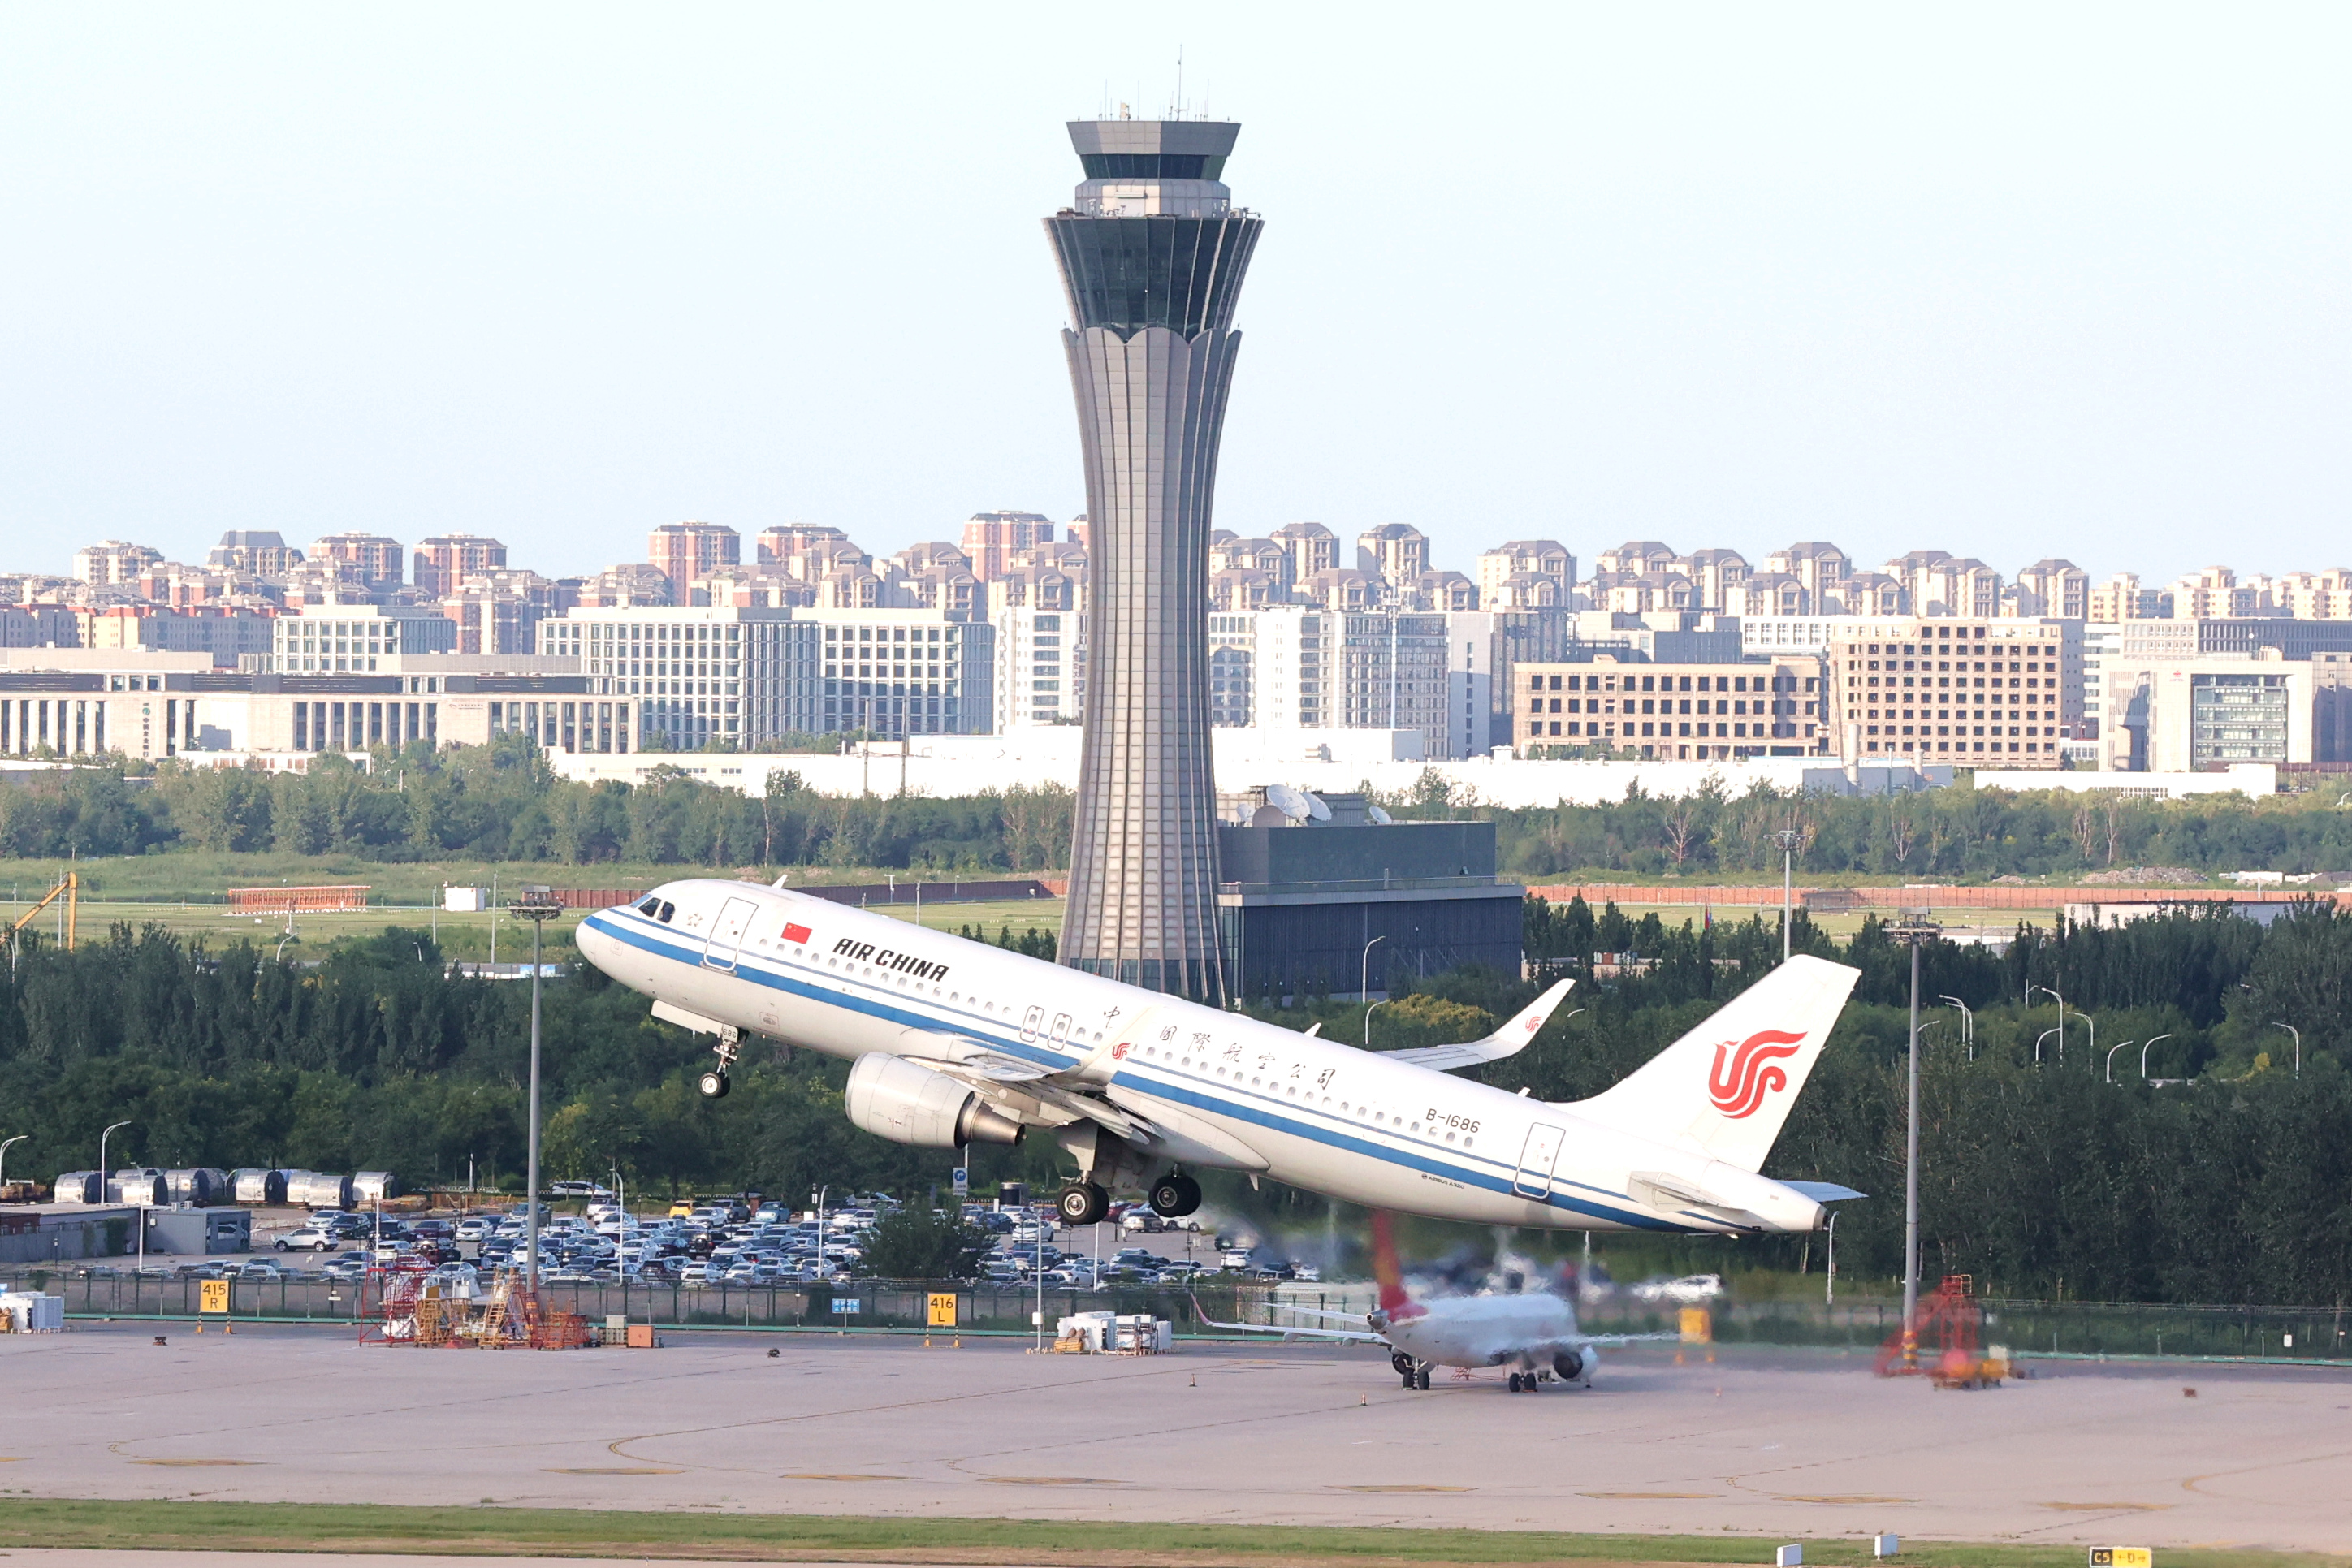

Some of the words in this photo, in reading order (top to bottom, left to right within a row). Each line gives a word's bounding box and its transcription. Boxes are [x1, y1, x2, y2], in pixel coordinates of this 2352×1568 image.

[832, 938, 876, 961] AIR
[875, 949, 950, 983] CHINA
[723, 1029, 736, 1038] 686
[1425, 1108, 1481, 1134] B-1686
[1429, 1177, 1448, 1186] AIRBUS
[1449, 1181, 1465, 1190] A320
[202, 1284, 226, 1296] 415
[210, 1298, 218, 1309] R
[930, 1297, 953, 1309] 416
[937, 1311, 945, 1322] L
